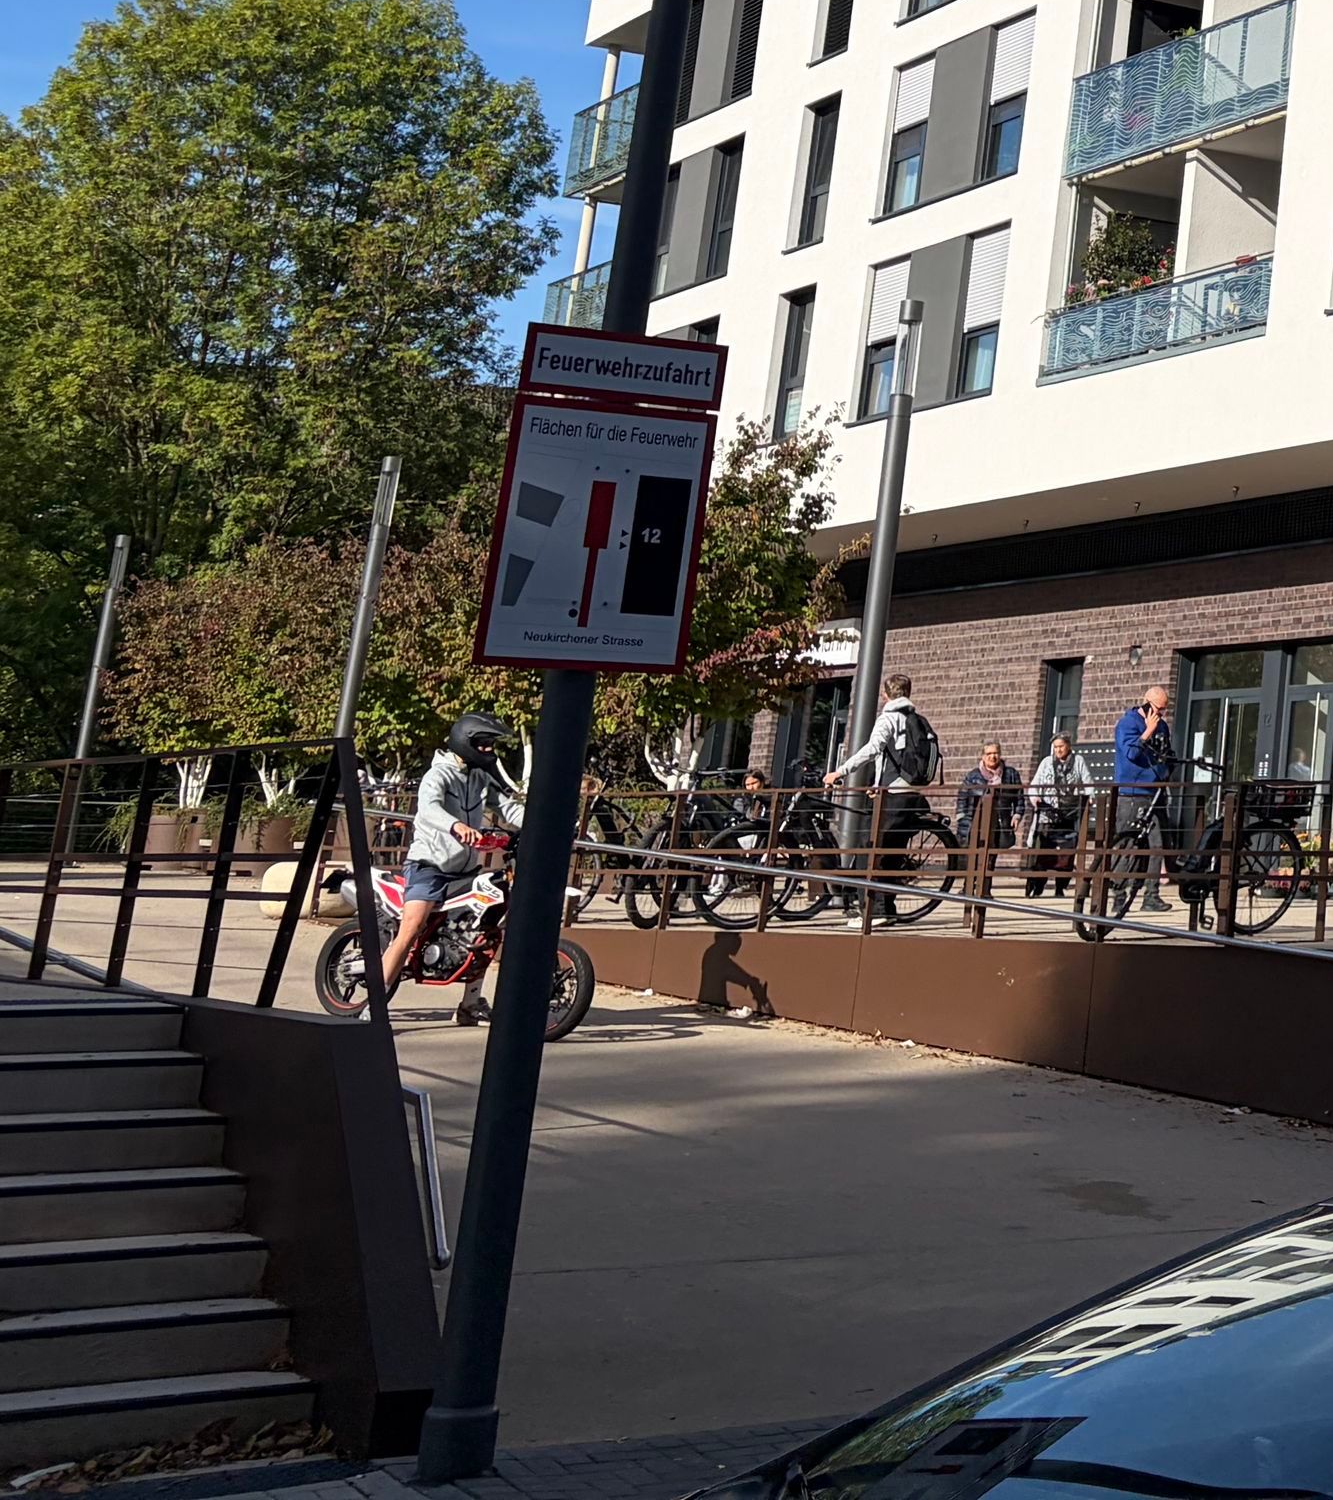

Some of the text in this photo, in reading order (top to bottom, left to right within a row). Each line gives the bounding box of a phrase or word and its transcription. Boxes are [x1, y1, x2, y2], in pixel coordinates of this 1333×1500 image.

[537, 347, 711, 387] Feuerwehrzufahrt
[530, 417, 698, 449] Flächen für die Feuerwehr
[641, 528, 661, 544] 12
[523, 631, 643, 647] Neukirchener Strasse
